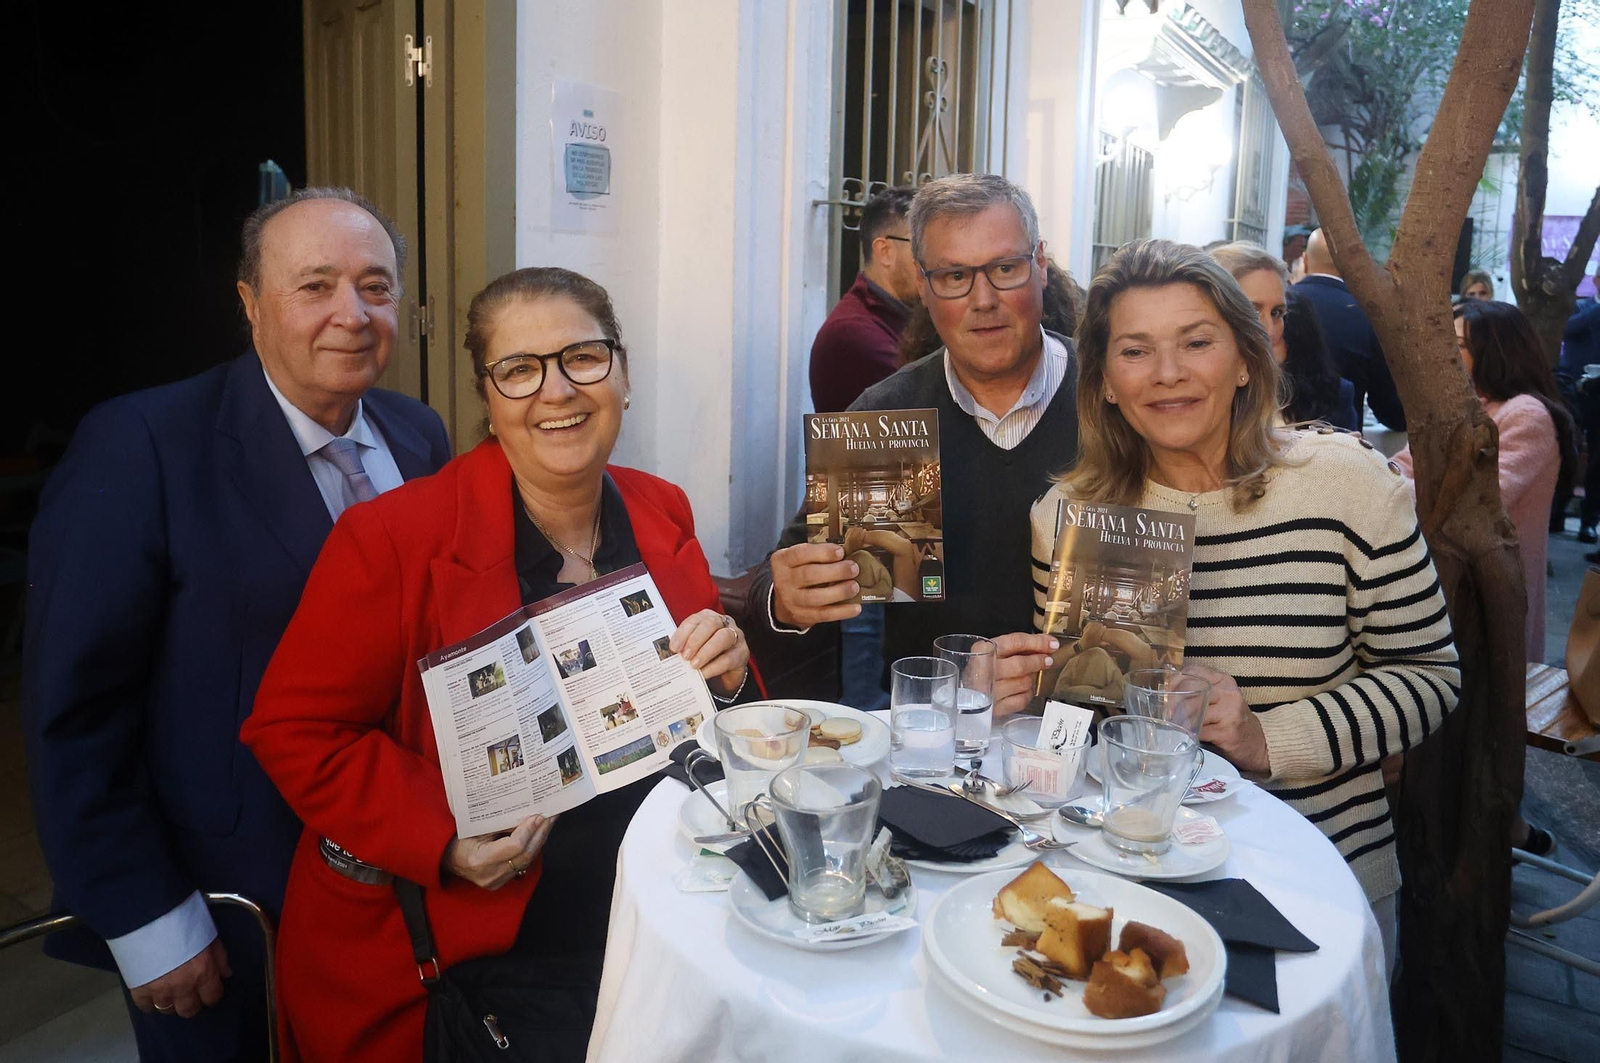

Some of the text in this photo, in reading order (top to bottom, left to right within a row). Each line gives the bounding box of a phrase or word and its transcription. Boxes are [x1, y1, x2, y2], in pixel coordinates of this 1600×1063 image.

[569, 121, 607, 142] AVISO
[811, 415, 929, 440] SEMANA SANTA
[846, 438, 930, 450] HUELVA Y PROVINCIA
[1065, 503, 1185, 541] SEMANA SANTA
[1100, 530, 1184, 553] HUELVA Y PROVINCIA
[440, 646, 467, 661] Ayamonte
